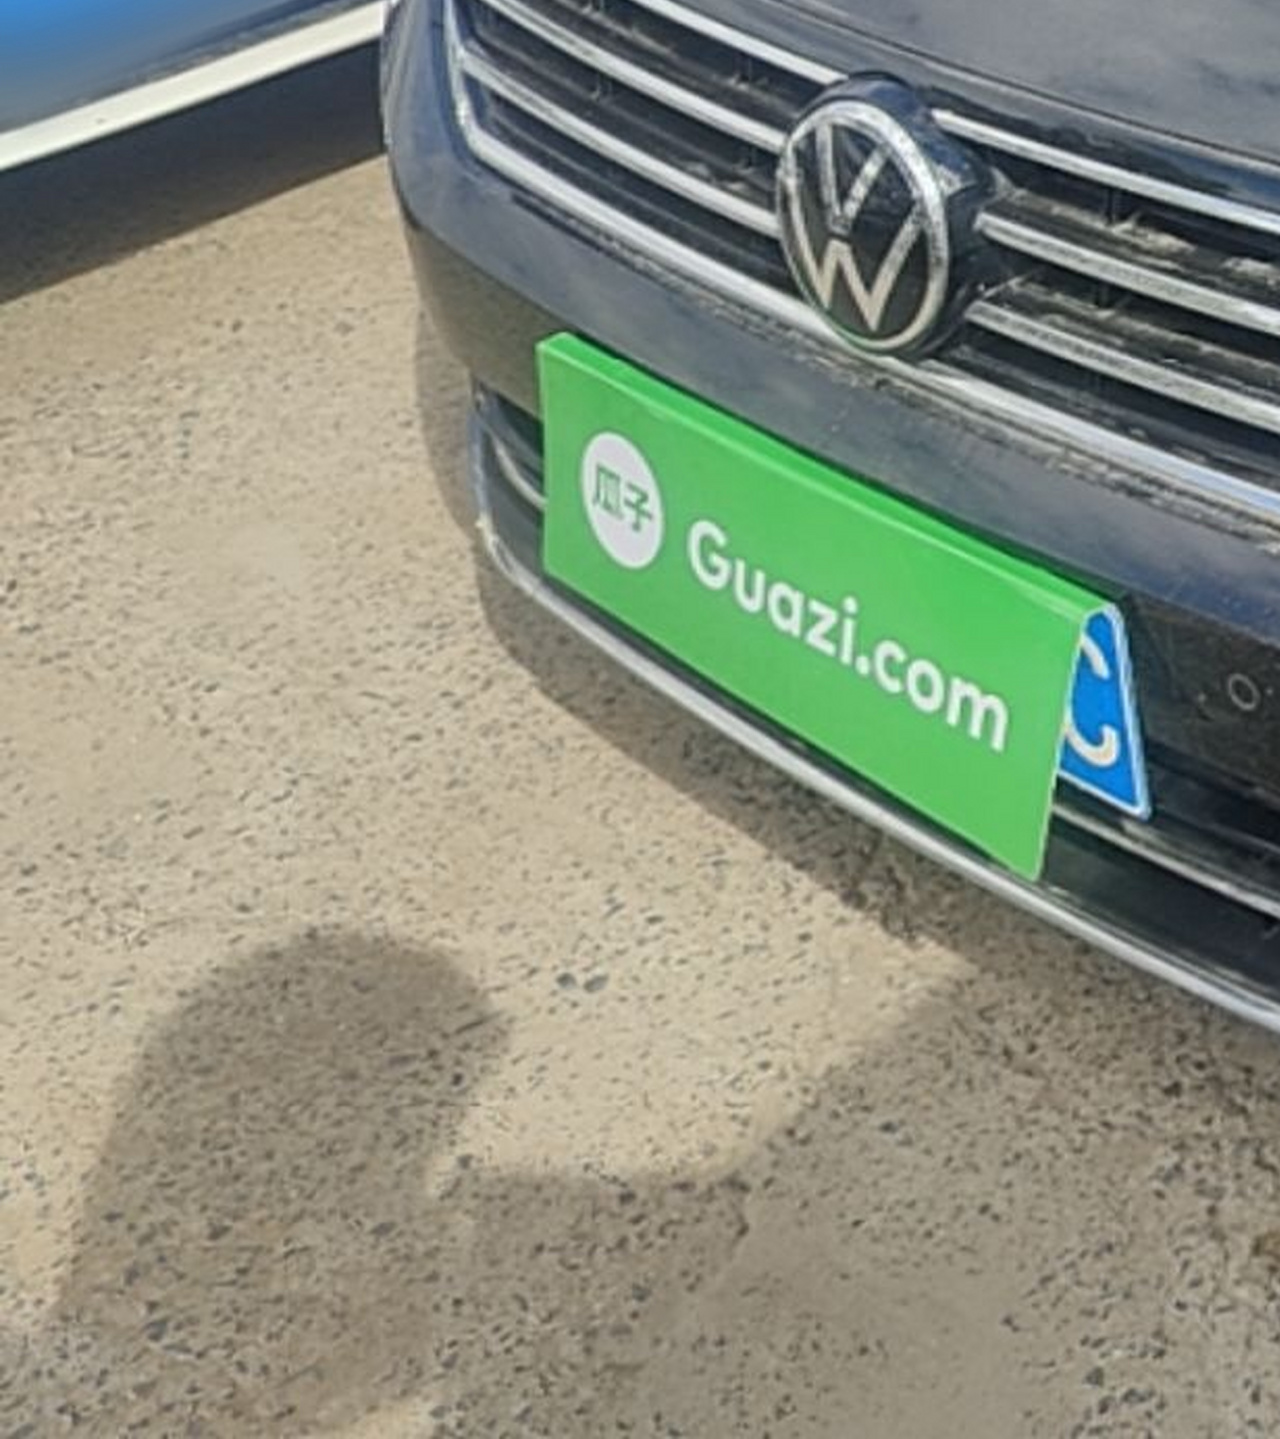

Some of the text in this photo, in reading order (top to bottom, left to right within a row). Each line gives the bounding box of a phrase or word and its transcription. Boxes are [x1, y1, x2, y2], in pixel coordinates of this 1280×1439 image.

[779, 104, 941, 343] VW
[592, 462, 1009, 754] 瓜子 Guazi.com
